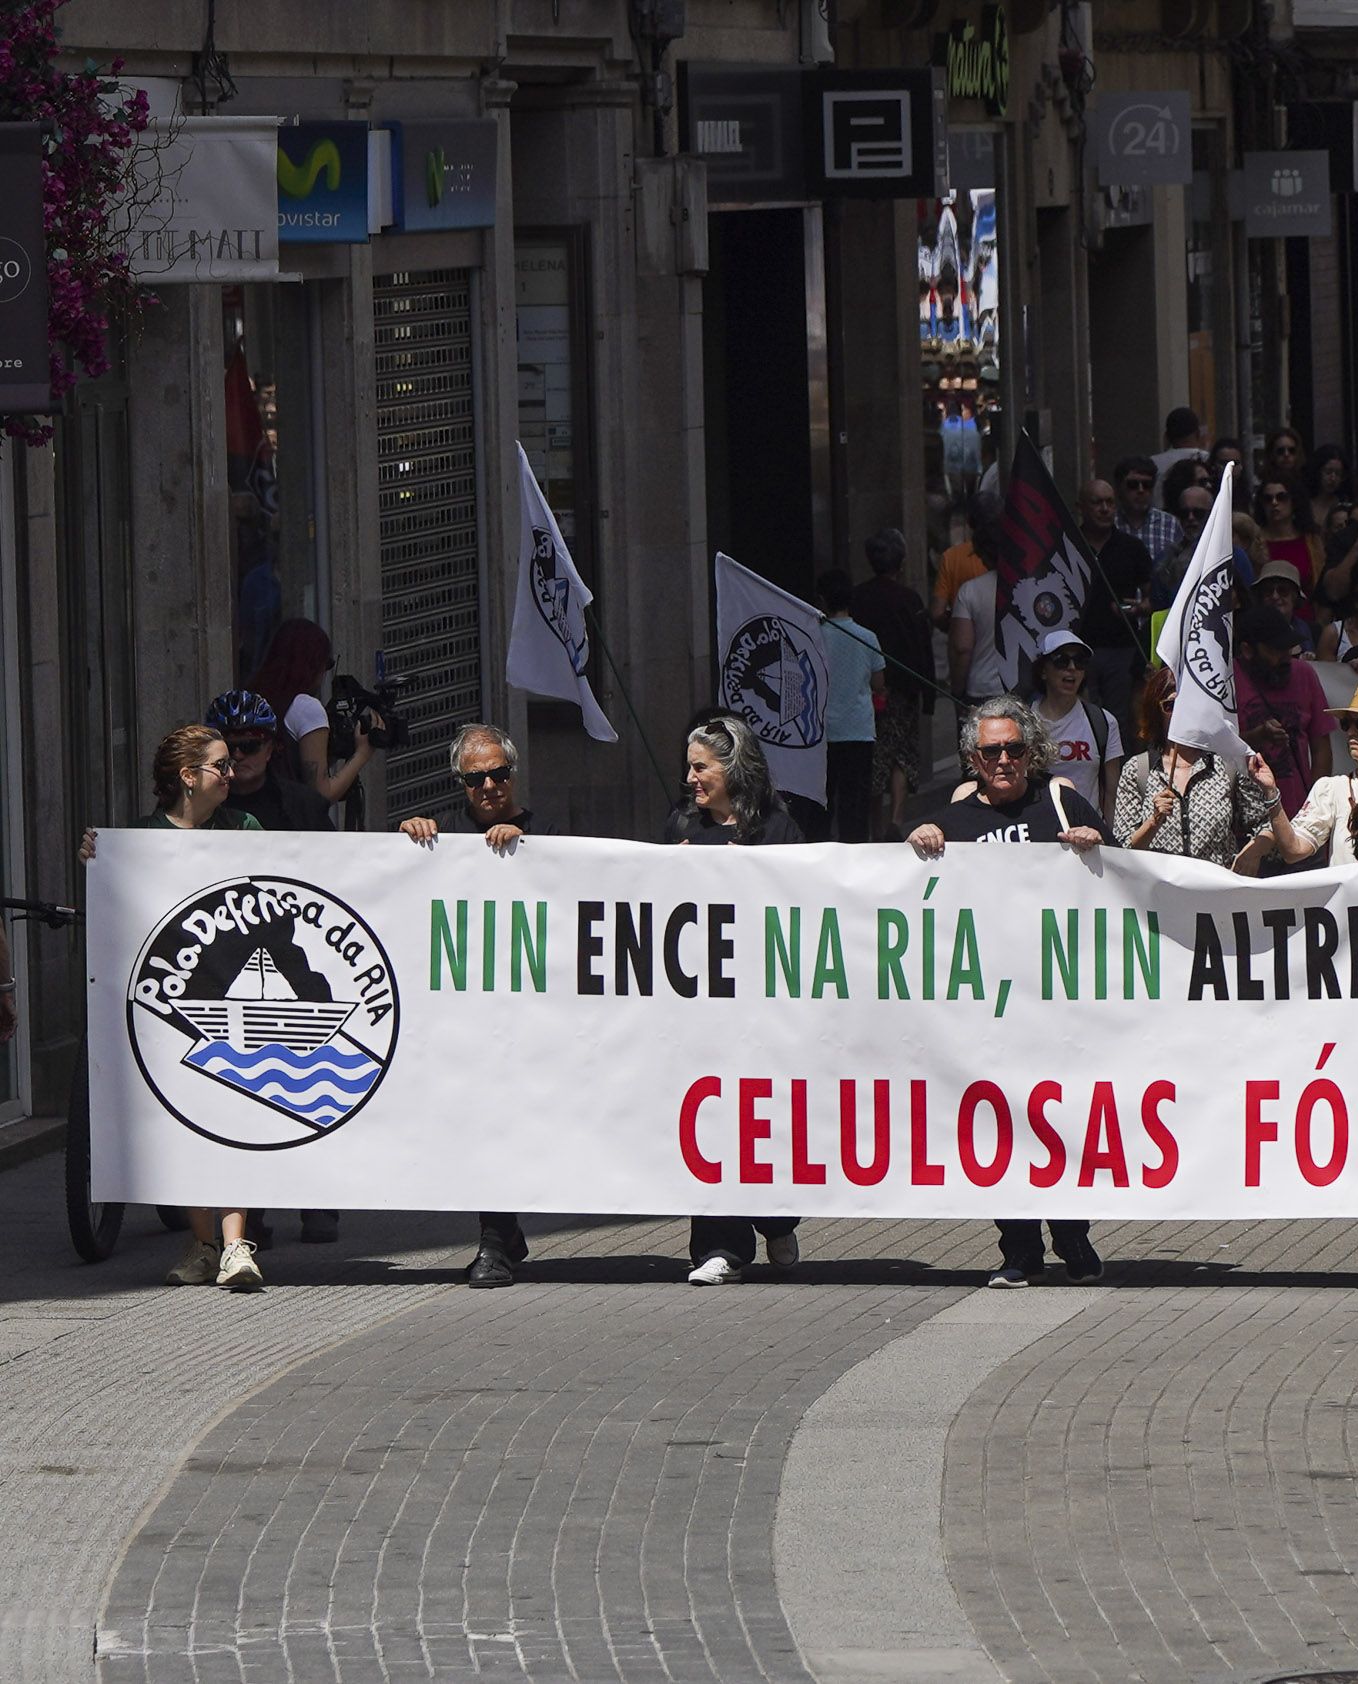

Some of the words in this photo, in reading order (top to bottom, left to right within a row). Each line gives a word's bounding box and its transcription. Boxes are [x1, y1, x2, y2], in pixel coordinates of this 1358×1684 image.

[1123, 120, 1167, 155] 24
[278, 211, 341, 227] ovistar
[1254, 201, 1321, 217] cajamar
[136, 943, 202, 1015] Pola
[182, 887, 326, 946] Defensa
[326, 922, 366, 968] da
[353, 963, 393, 1027] RIA
[430, 900, 547, 992] NIN
[577, 901, 735, 998] ENCE
[765, 906, 849, 998] NA
[877, 877, 1012, 1017] RÍA,
[1041, 908, 1160, 1000] NIN
[679, 1075, 1180, 1189] CELULOSAS
